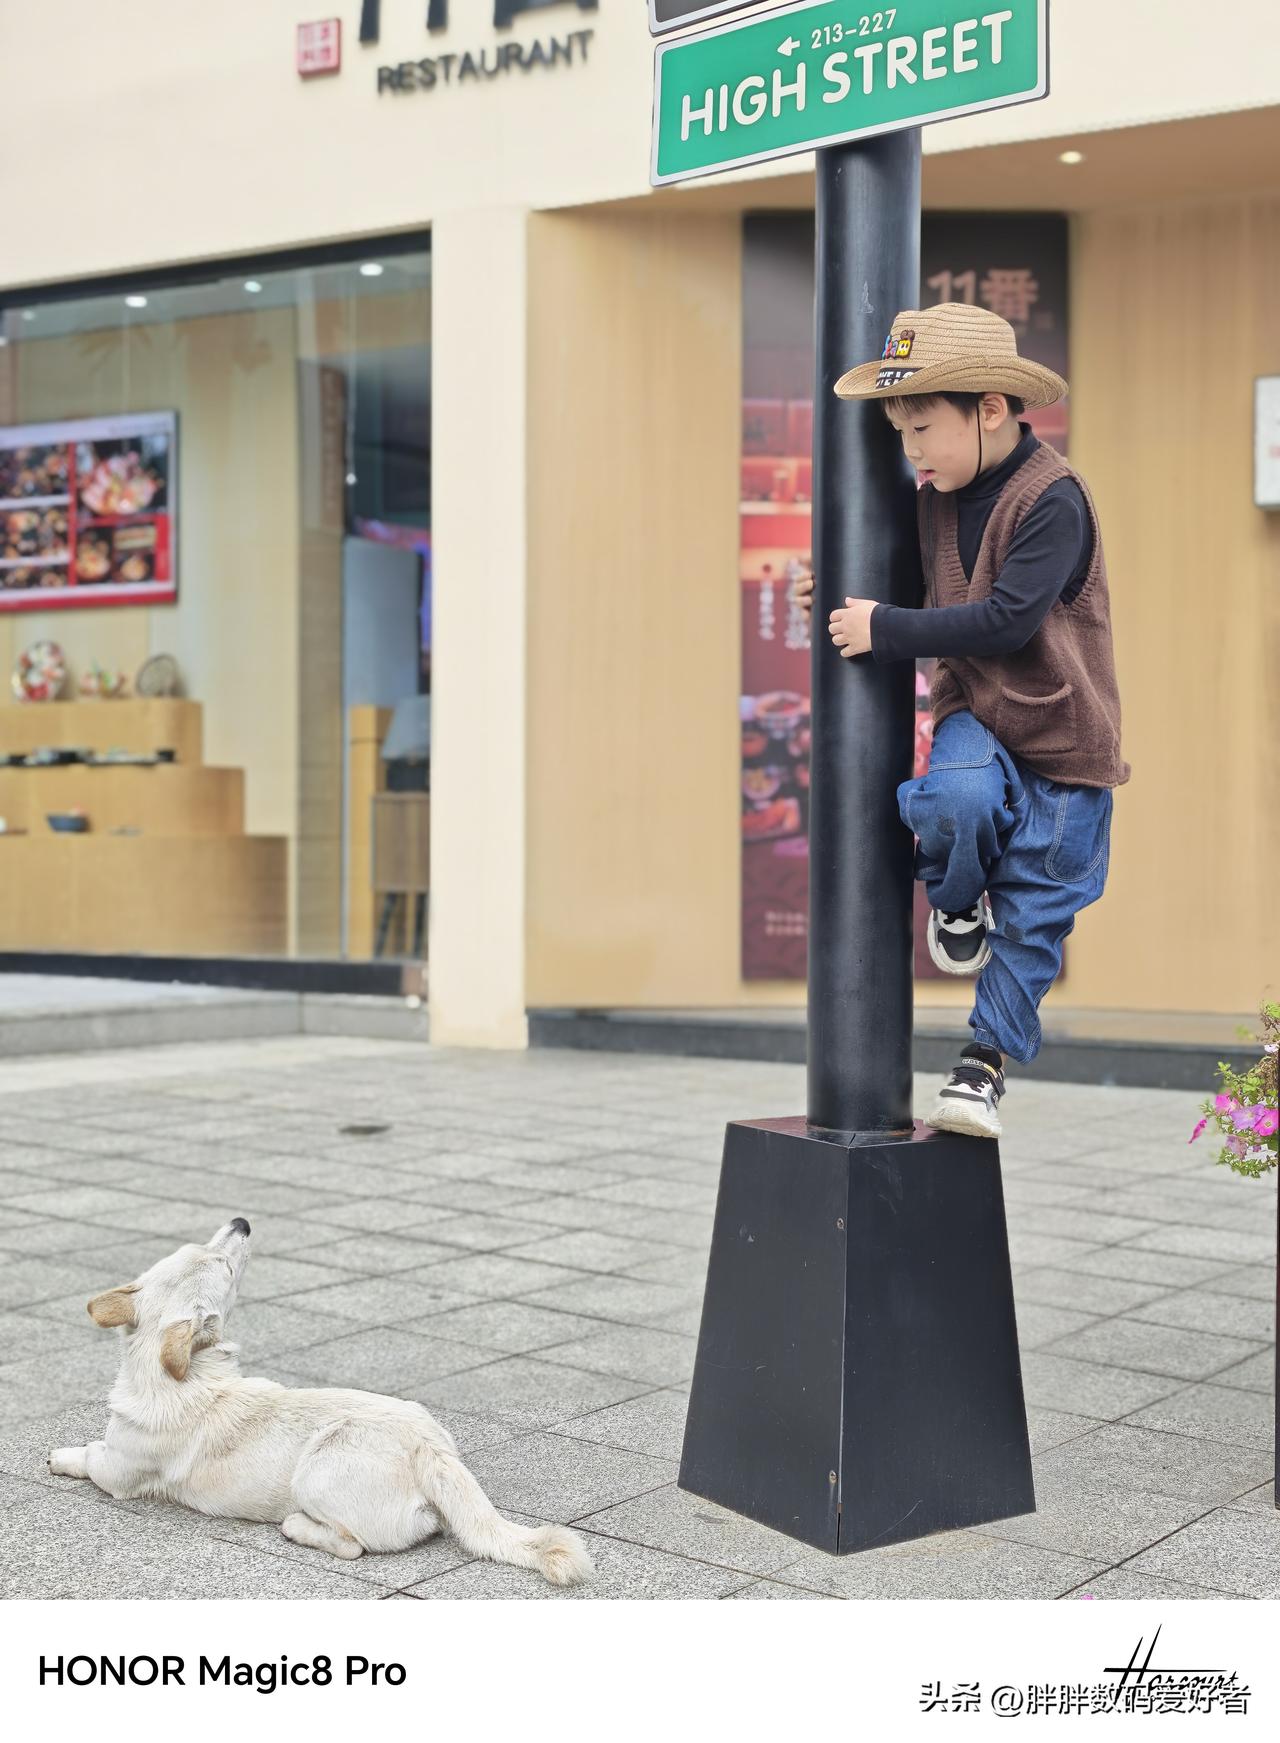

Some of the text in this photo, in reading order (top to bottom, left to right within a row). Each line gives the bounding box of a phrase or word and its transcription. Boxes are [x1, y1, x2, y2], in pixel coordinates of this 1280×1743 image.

[811, 8, 897, 49] 213-227
[377, 29, 594, 94] RESTAURANT
[680, 10, 1013, 141] HIGH STREET
